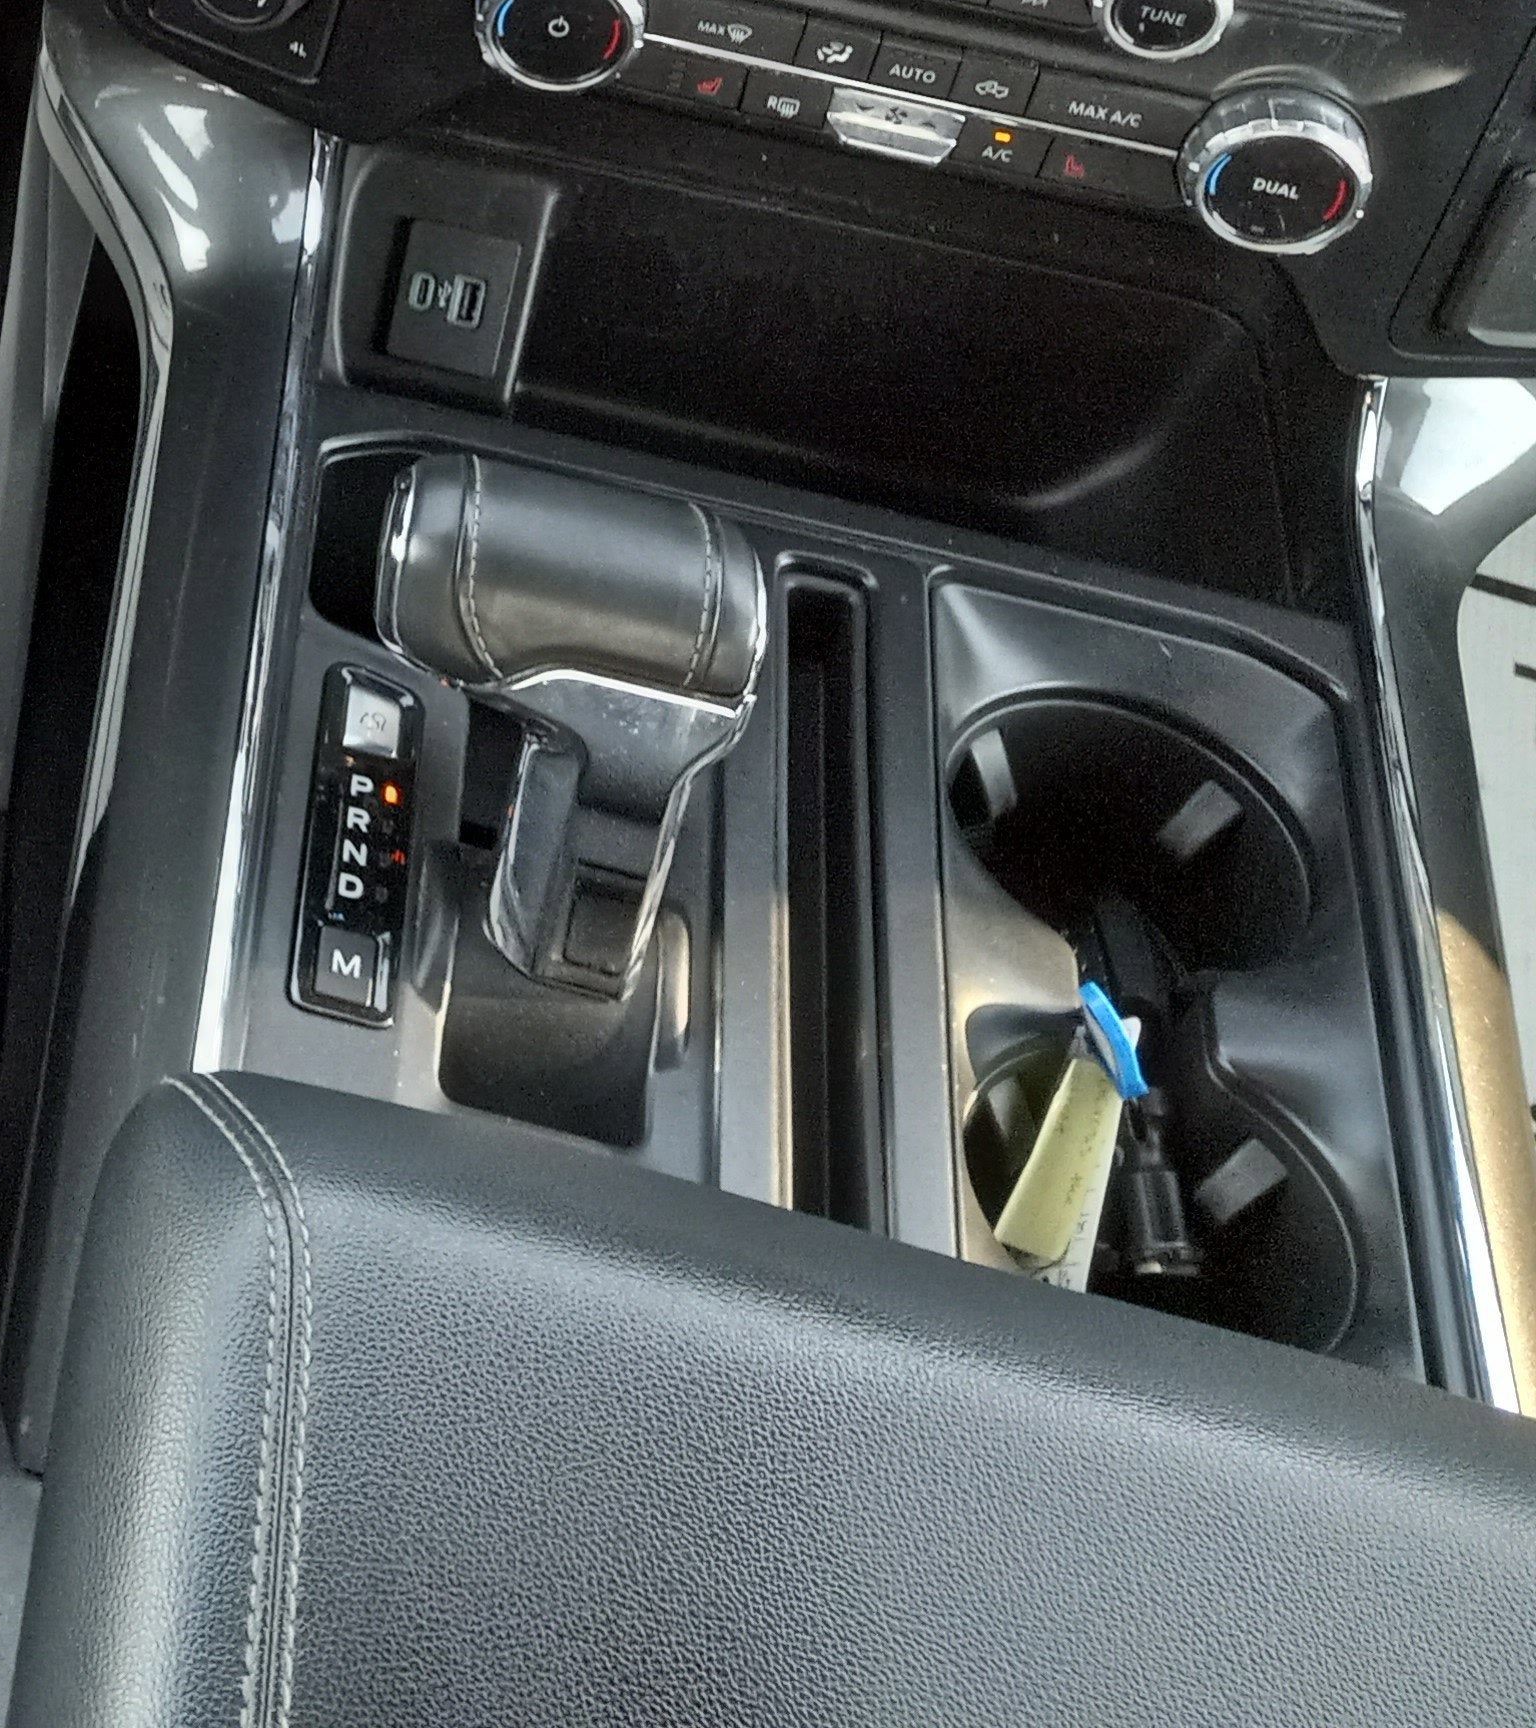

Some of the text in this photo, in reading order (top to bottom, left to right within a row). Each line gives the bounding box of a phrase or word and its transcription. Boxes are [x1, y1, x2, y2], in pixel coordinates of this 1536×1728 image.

[697, 20, 727, 36] MAX
[1140, 6, 1188, 27] TUNE
[290, 40, 307, 58] 4L
[889, 63, 936, 83] AUTO
[1068, 100, 1143, 129] MAX A/C
[981, 146, 1014, 163] A/C
[1252, 177, 1299, 200] DUAL
[350, 774, 374, 798] P
[346, 806, 371, 833] R
[343, 838, 368, 866] N
[338, 873, 364, 900] D
[331, 949, 362, 979] M
